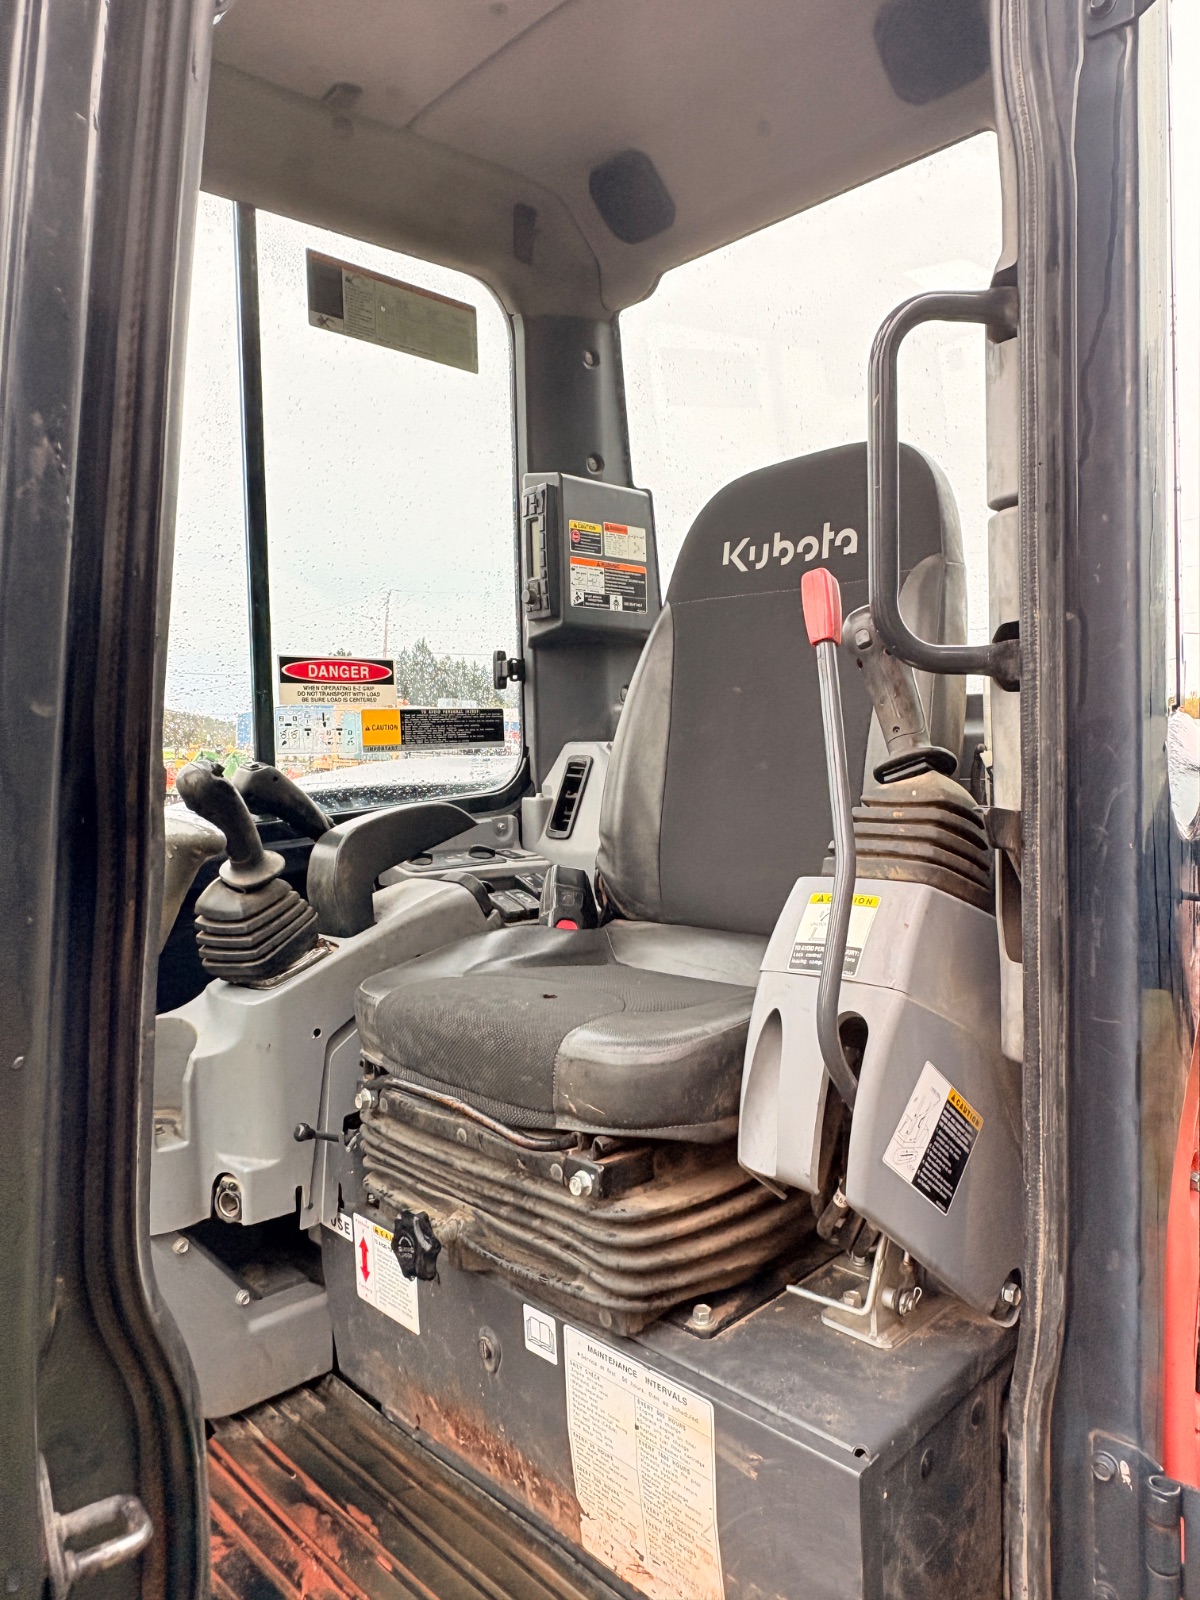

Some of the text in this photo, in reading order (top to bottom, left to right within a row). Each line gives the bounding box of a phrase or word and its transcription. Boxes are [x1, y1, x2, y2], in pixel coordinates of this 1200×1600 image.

[722, 522, 858, 572] Kubota
[308, 664, 370, 679] DANGER
[955, 1098, 981, 1127] CAUTION
[587, 1343, 687, 1407] MAINTENANCE INTERVALS
[667, 1415, 685, 1431] HOURS
